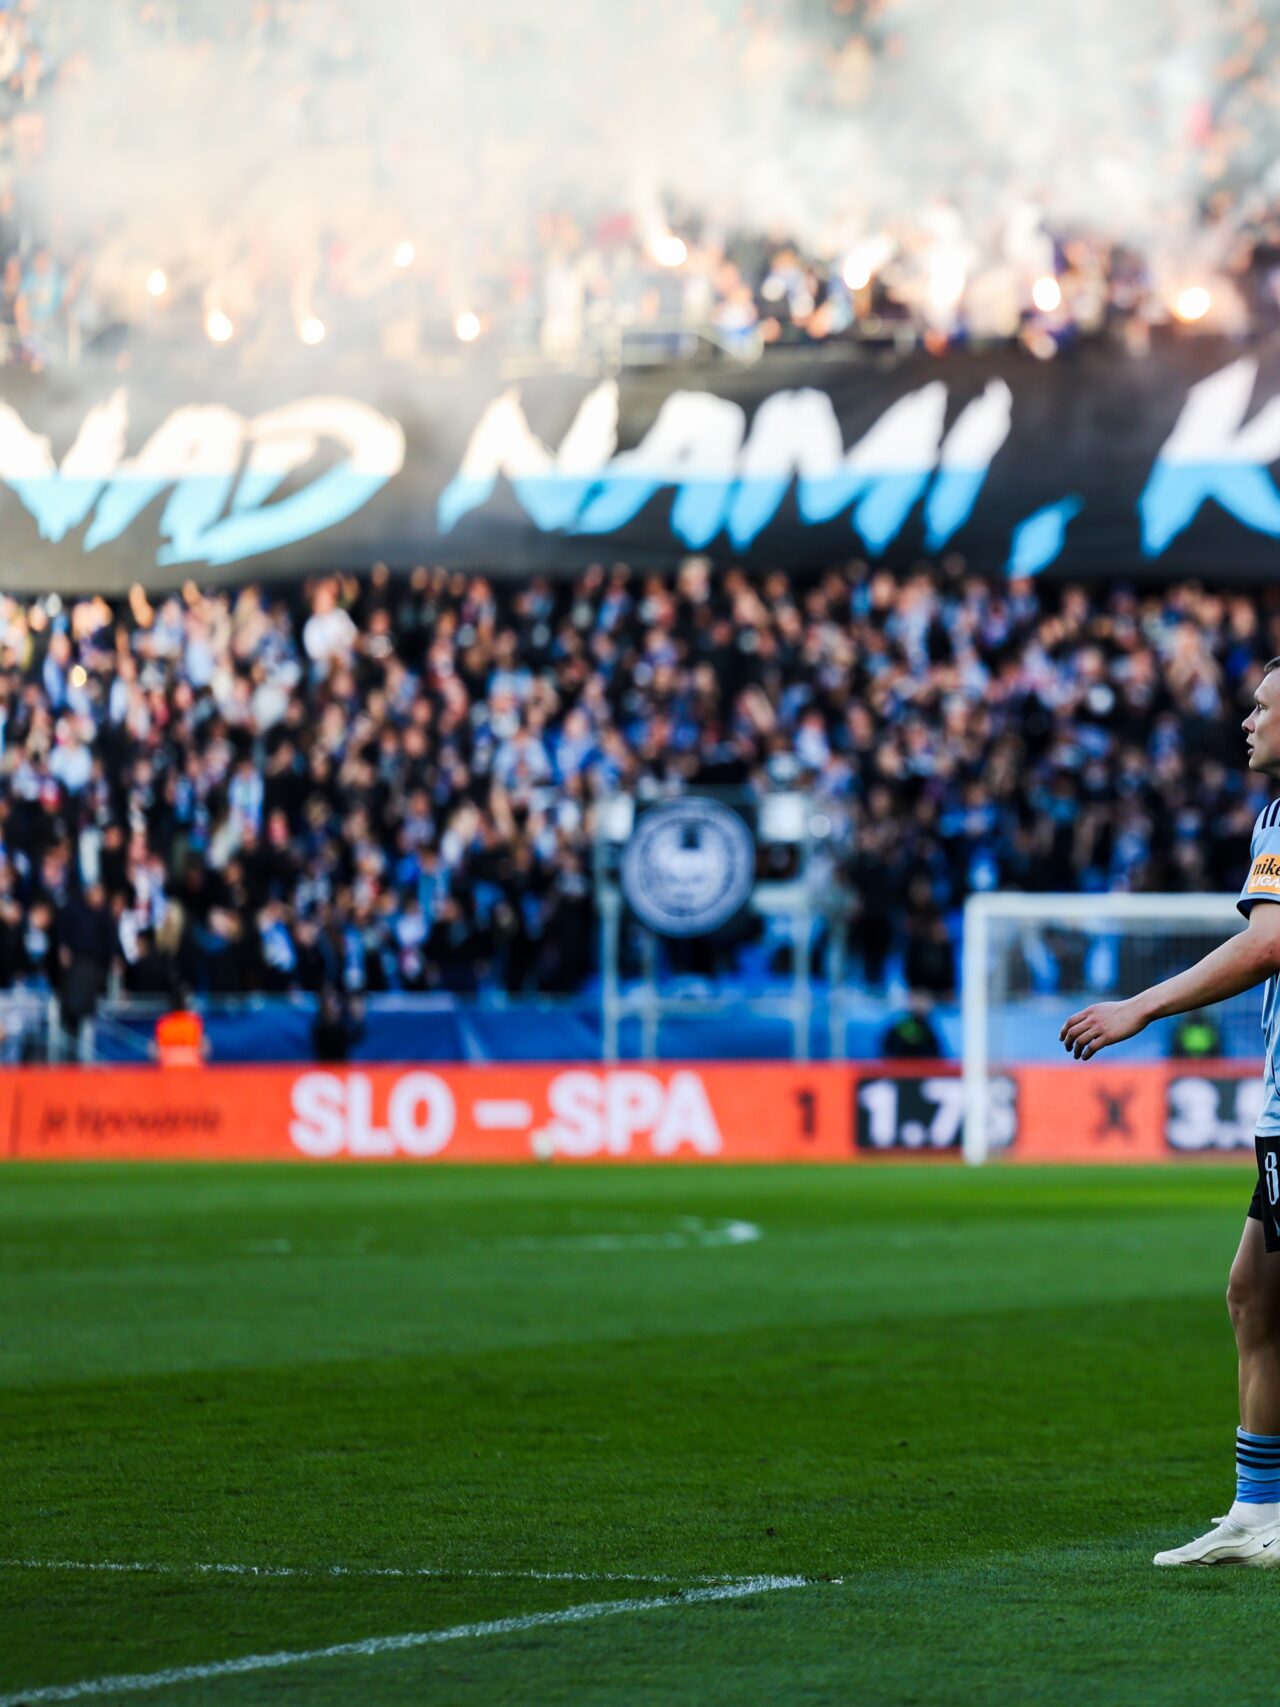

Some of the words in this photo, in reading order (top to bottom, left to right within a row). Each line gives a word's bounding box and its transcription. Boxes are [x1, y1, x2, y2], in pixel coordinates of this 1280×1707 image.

[0, 387, 405, 567] NAD
[288, 1070, 456, 1157] SLO
[547, 1070, 723, 1157] SPA
[1265, 1152, 1280, 1206] 8
